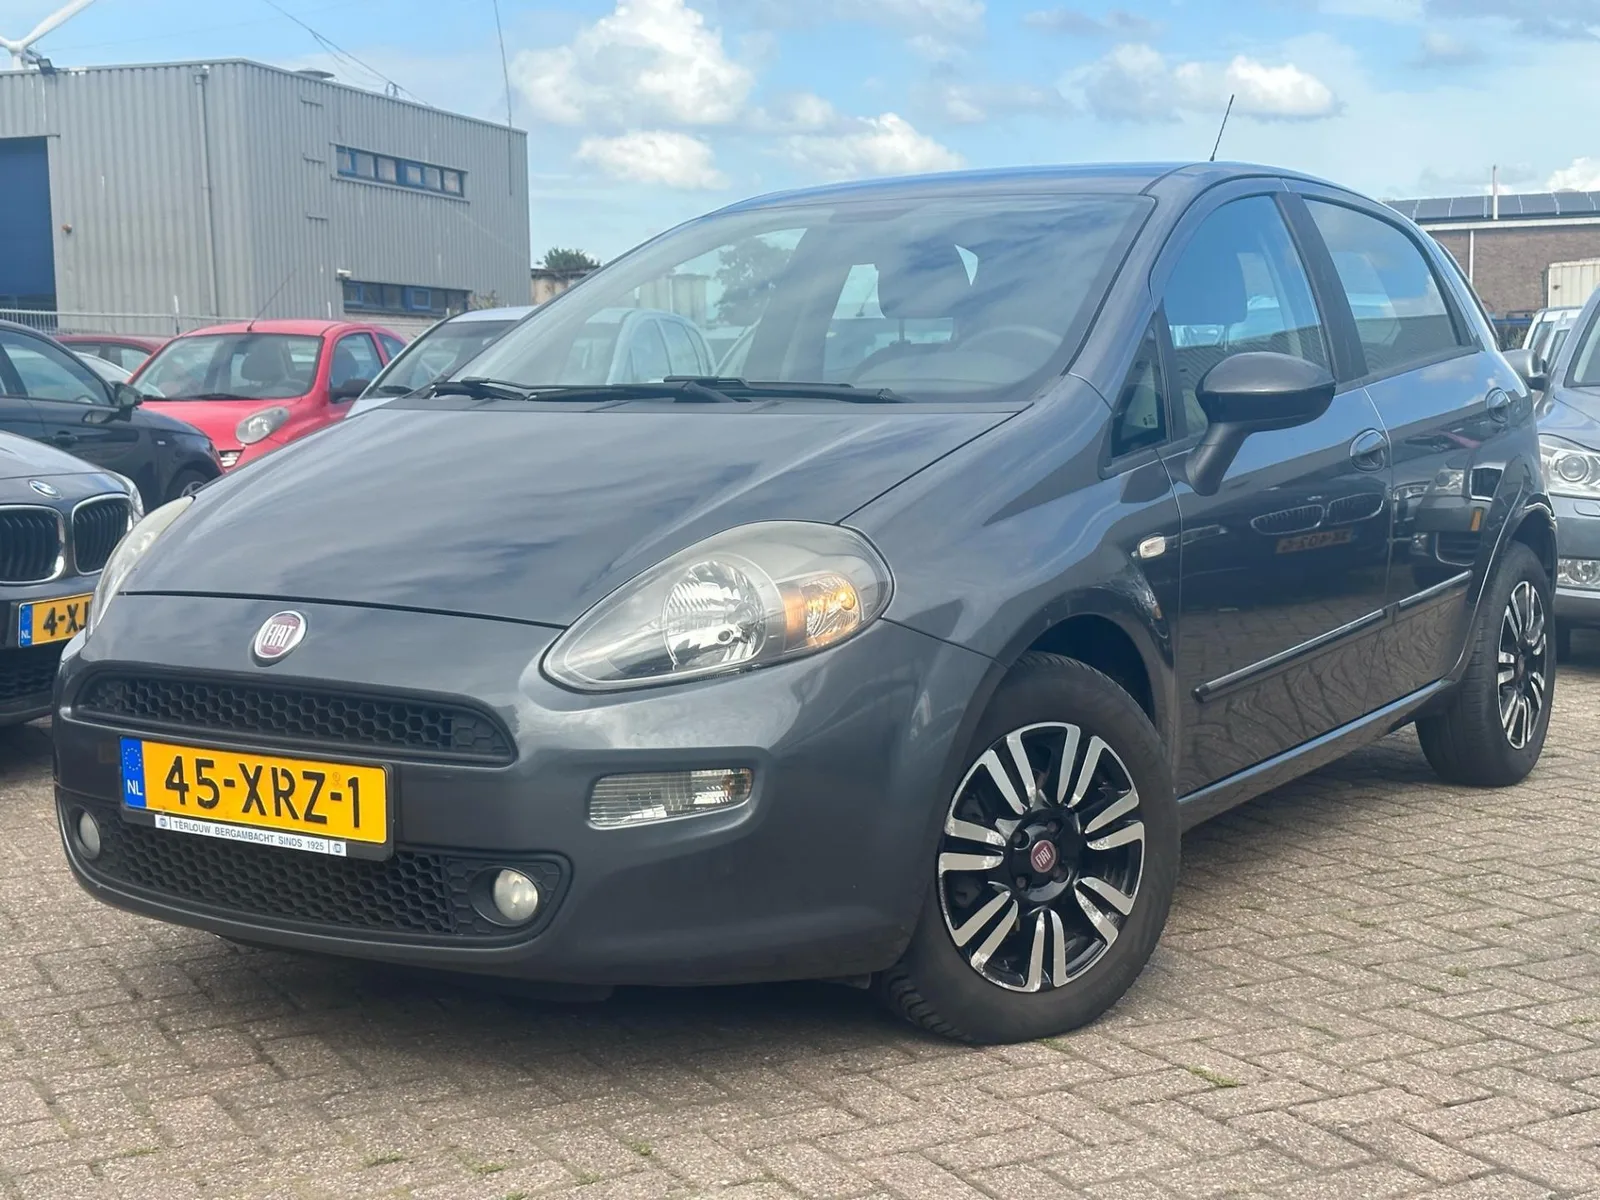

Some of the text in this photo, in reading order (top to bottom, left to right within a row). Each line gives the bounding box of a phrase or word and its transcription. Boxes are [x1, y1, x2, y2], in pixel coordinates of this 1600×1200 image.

[21, 630, 31, 639] NL
[262, 623, 297, 648] FIAT
[127, 755, 361, 829] NL 45-XRZ-1
[215, 827, 274, 843] BERGAMBACHT
[278, 836, 303, 847] SINDS
[307, 840, 325, 851] 1925
[1034, 845, 1052, 868] FIAT
